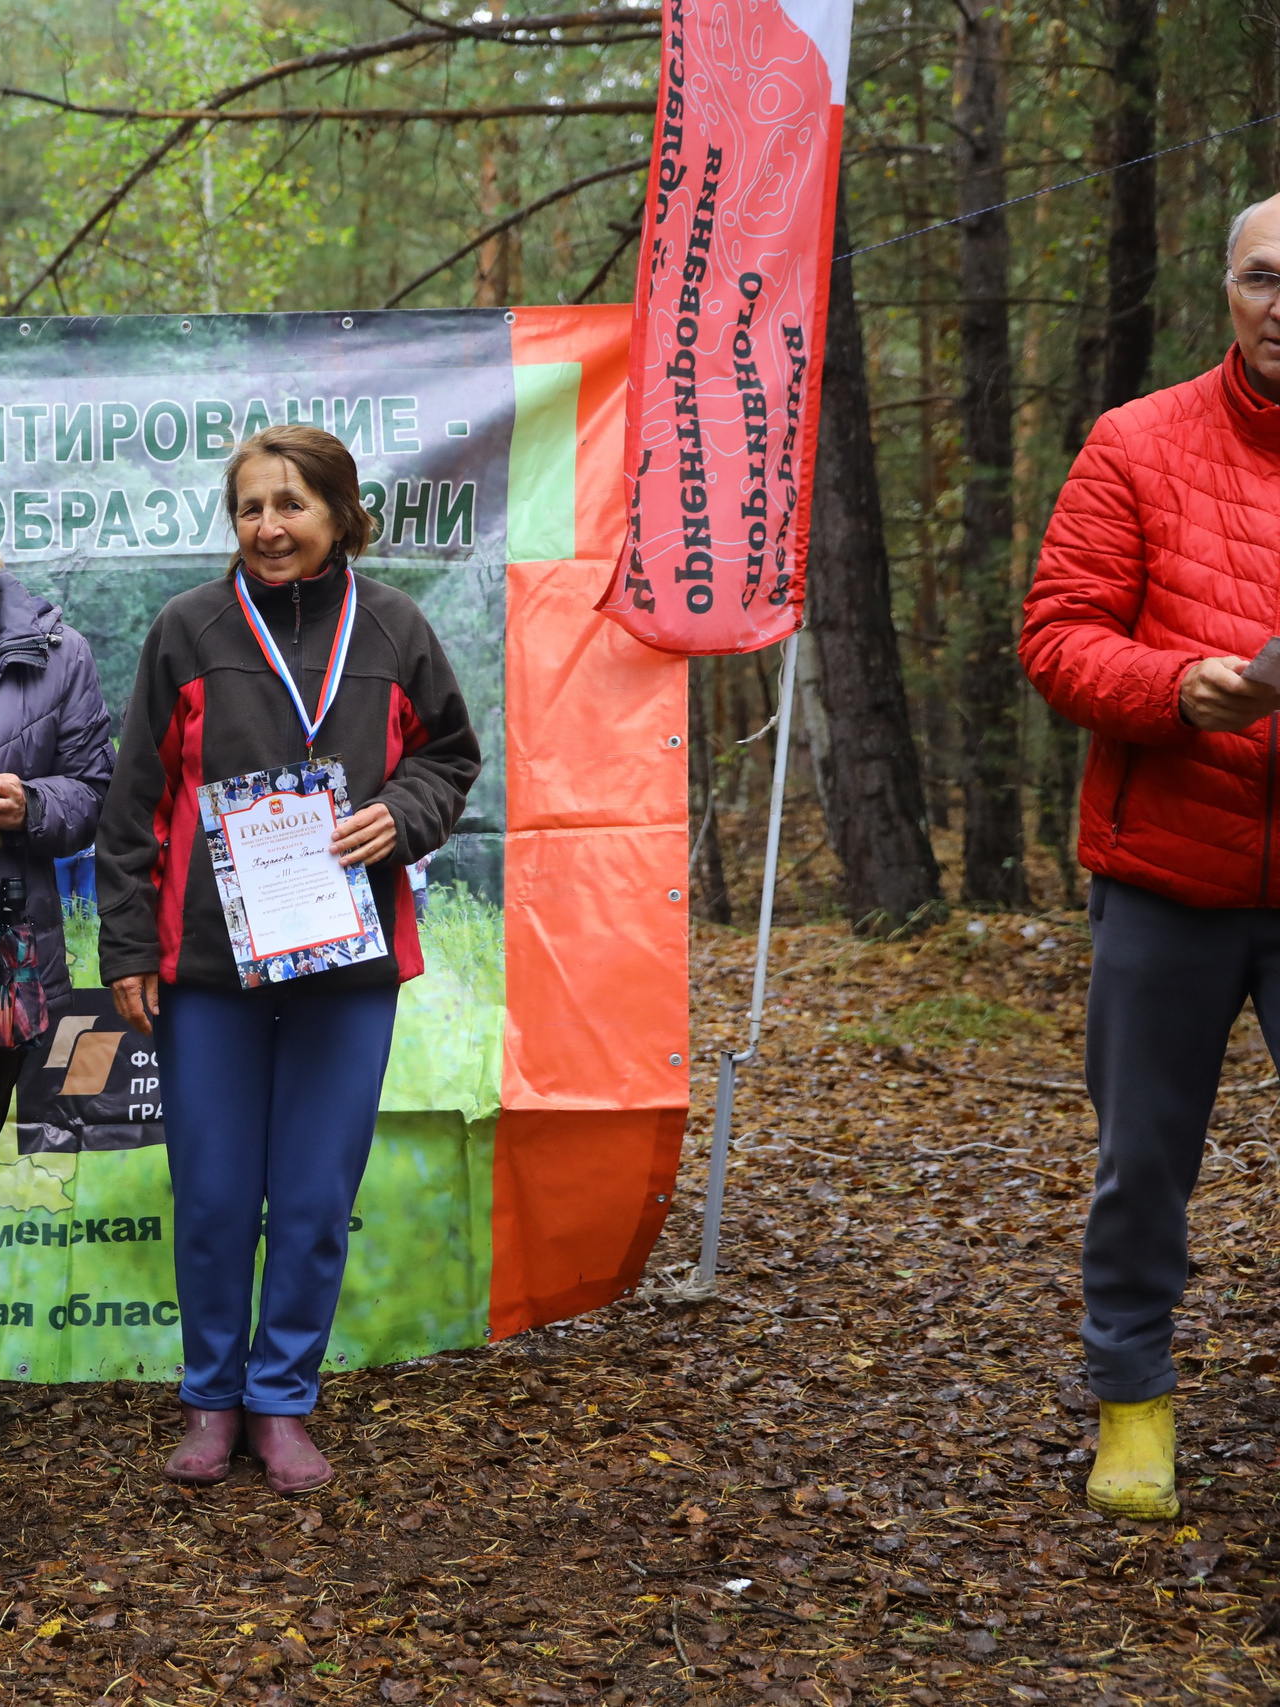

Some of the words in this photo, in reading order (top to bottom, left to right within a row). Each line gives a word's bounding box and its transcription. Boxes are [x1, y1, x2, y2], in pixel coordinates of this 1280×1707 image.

[359, 480, 477, 547] ЗНИ
[238, 810, 322, 839] ГРАМОТА
[130, 1077, 159, 1095] ПР
[128, 1102, 163, 1121] ГРА
[48, 1293, 180, 1331] облас
